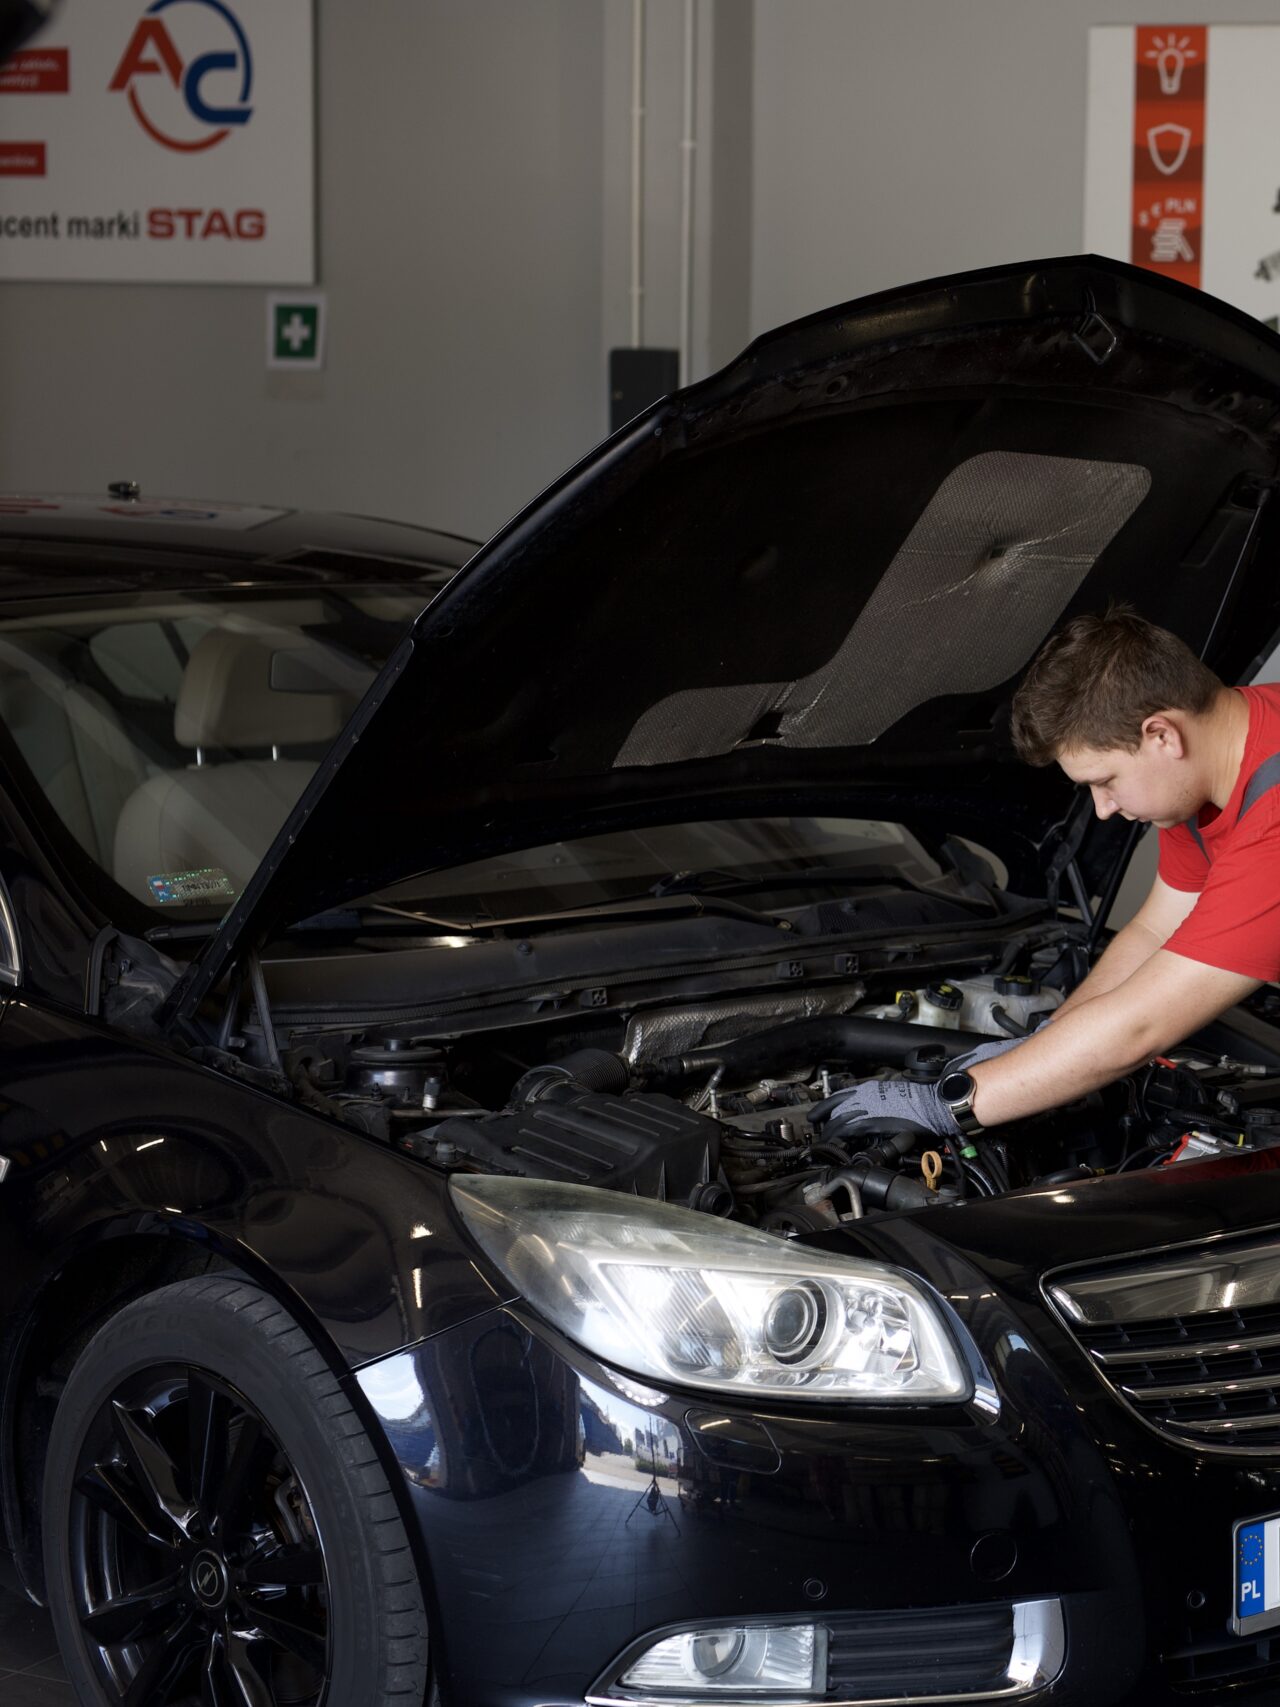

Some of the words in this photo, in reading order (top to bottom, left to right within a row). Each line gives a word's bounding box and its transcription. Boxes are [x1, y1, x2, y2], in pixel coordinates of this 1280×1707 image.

[0, 210, 60, 239] cent
[67, 210, 140, 239] marki
[146, 207, 266, 240] STAG
[1241, 1580, 1261, 1602] PL
